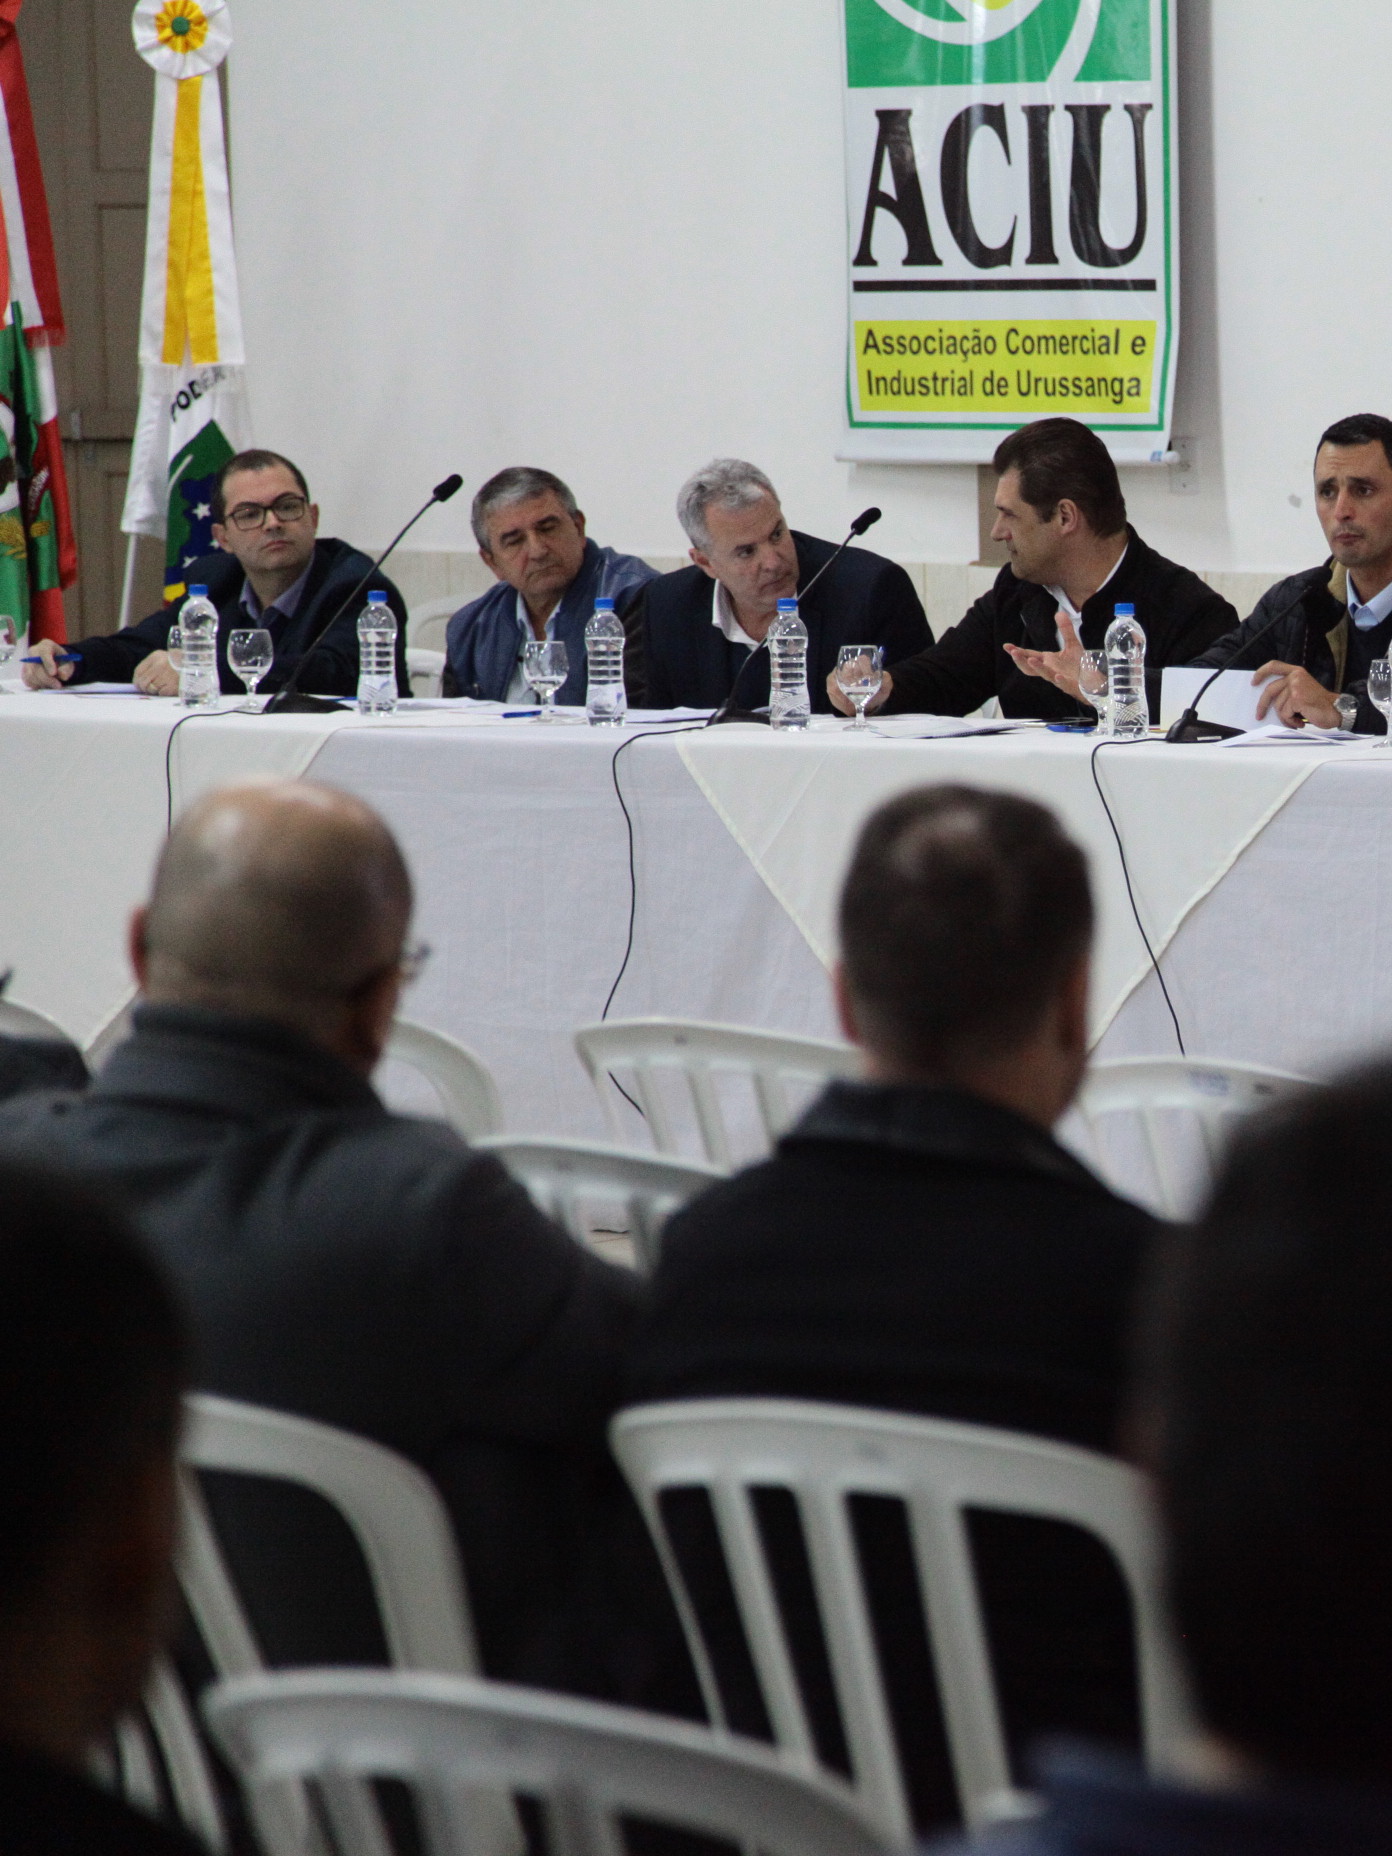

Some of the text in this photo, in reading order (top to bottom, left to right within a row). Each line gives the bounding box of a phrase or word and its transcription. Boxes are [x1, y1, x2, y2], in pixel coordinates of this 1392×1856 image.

[852, 102, 1153, 269] ACIU
[863, 328, 1146, 362] Associação Comercial e
[867, 370, 1141, 405] Industrial de Urussanga
